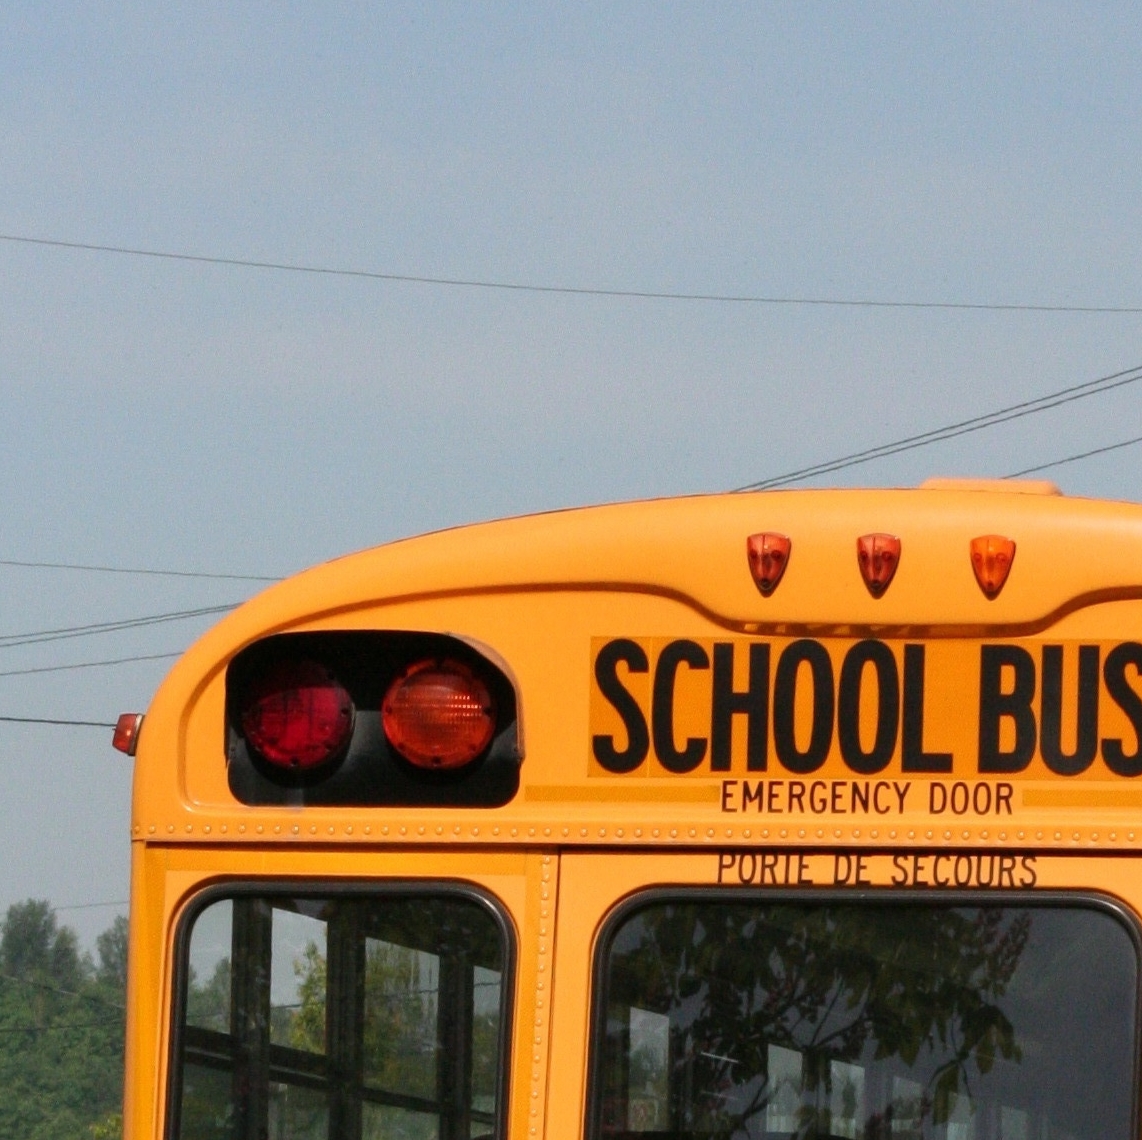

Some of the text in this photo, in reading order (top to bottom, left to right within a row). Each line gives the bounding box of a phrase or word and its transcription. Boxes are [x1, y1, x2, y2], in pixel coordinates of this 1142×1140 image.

[592, 638, 953, 774] SCHOOL
[721, 781, 1013, 815] EMERGENCY DOOR
[717, 851, 1037, 888] PORTE DE SECOURS
